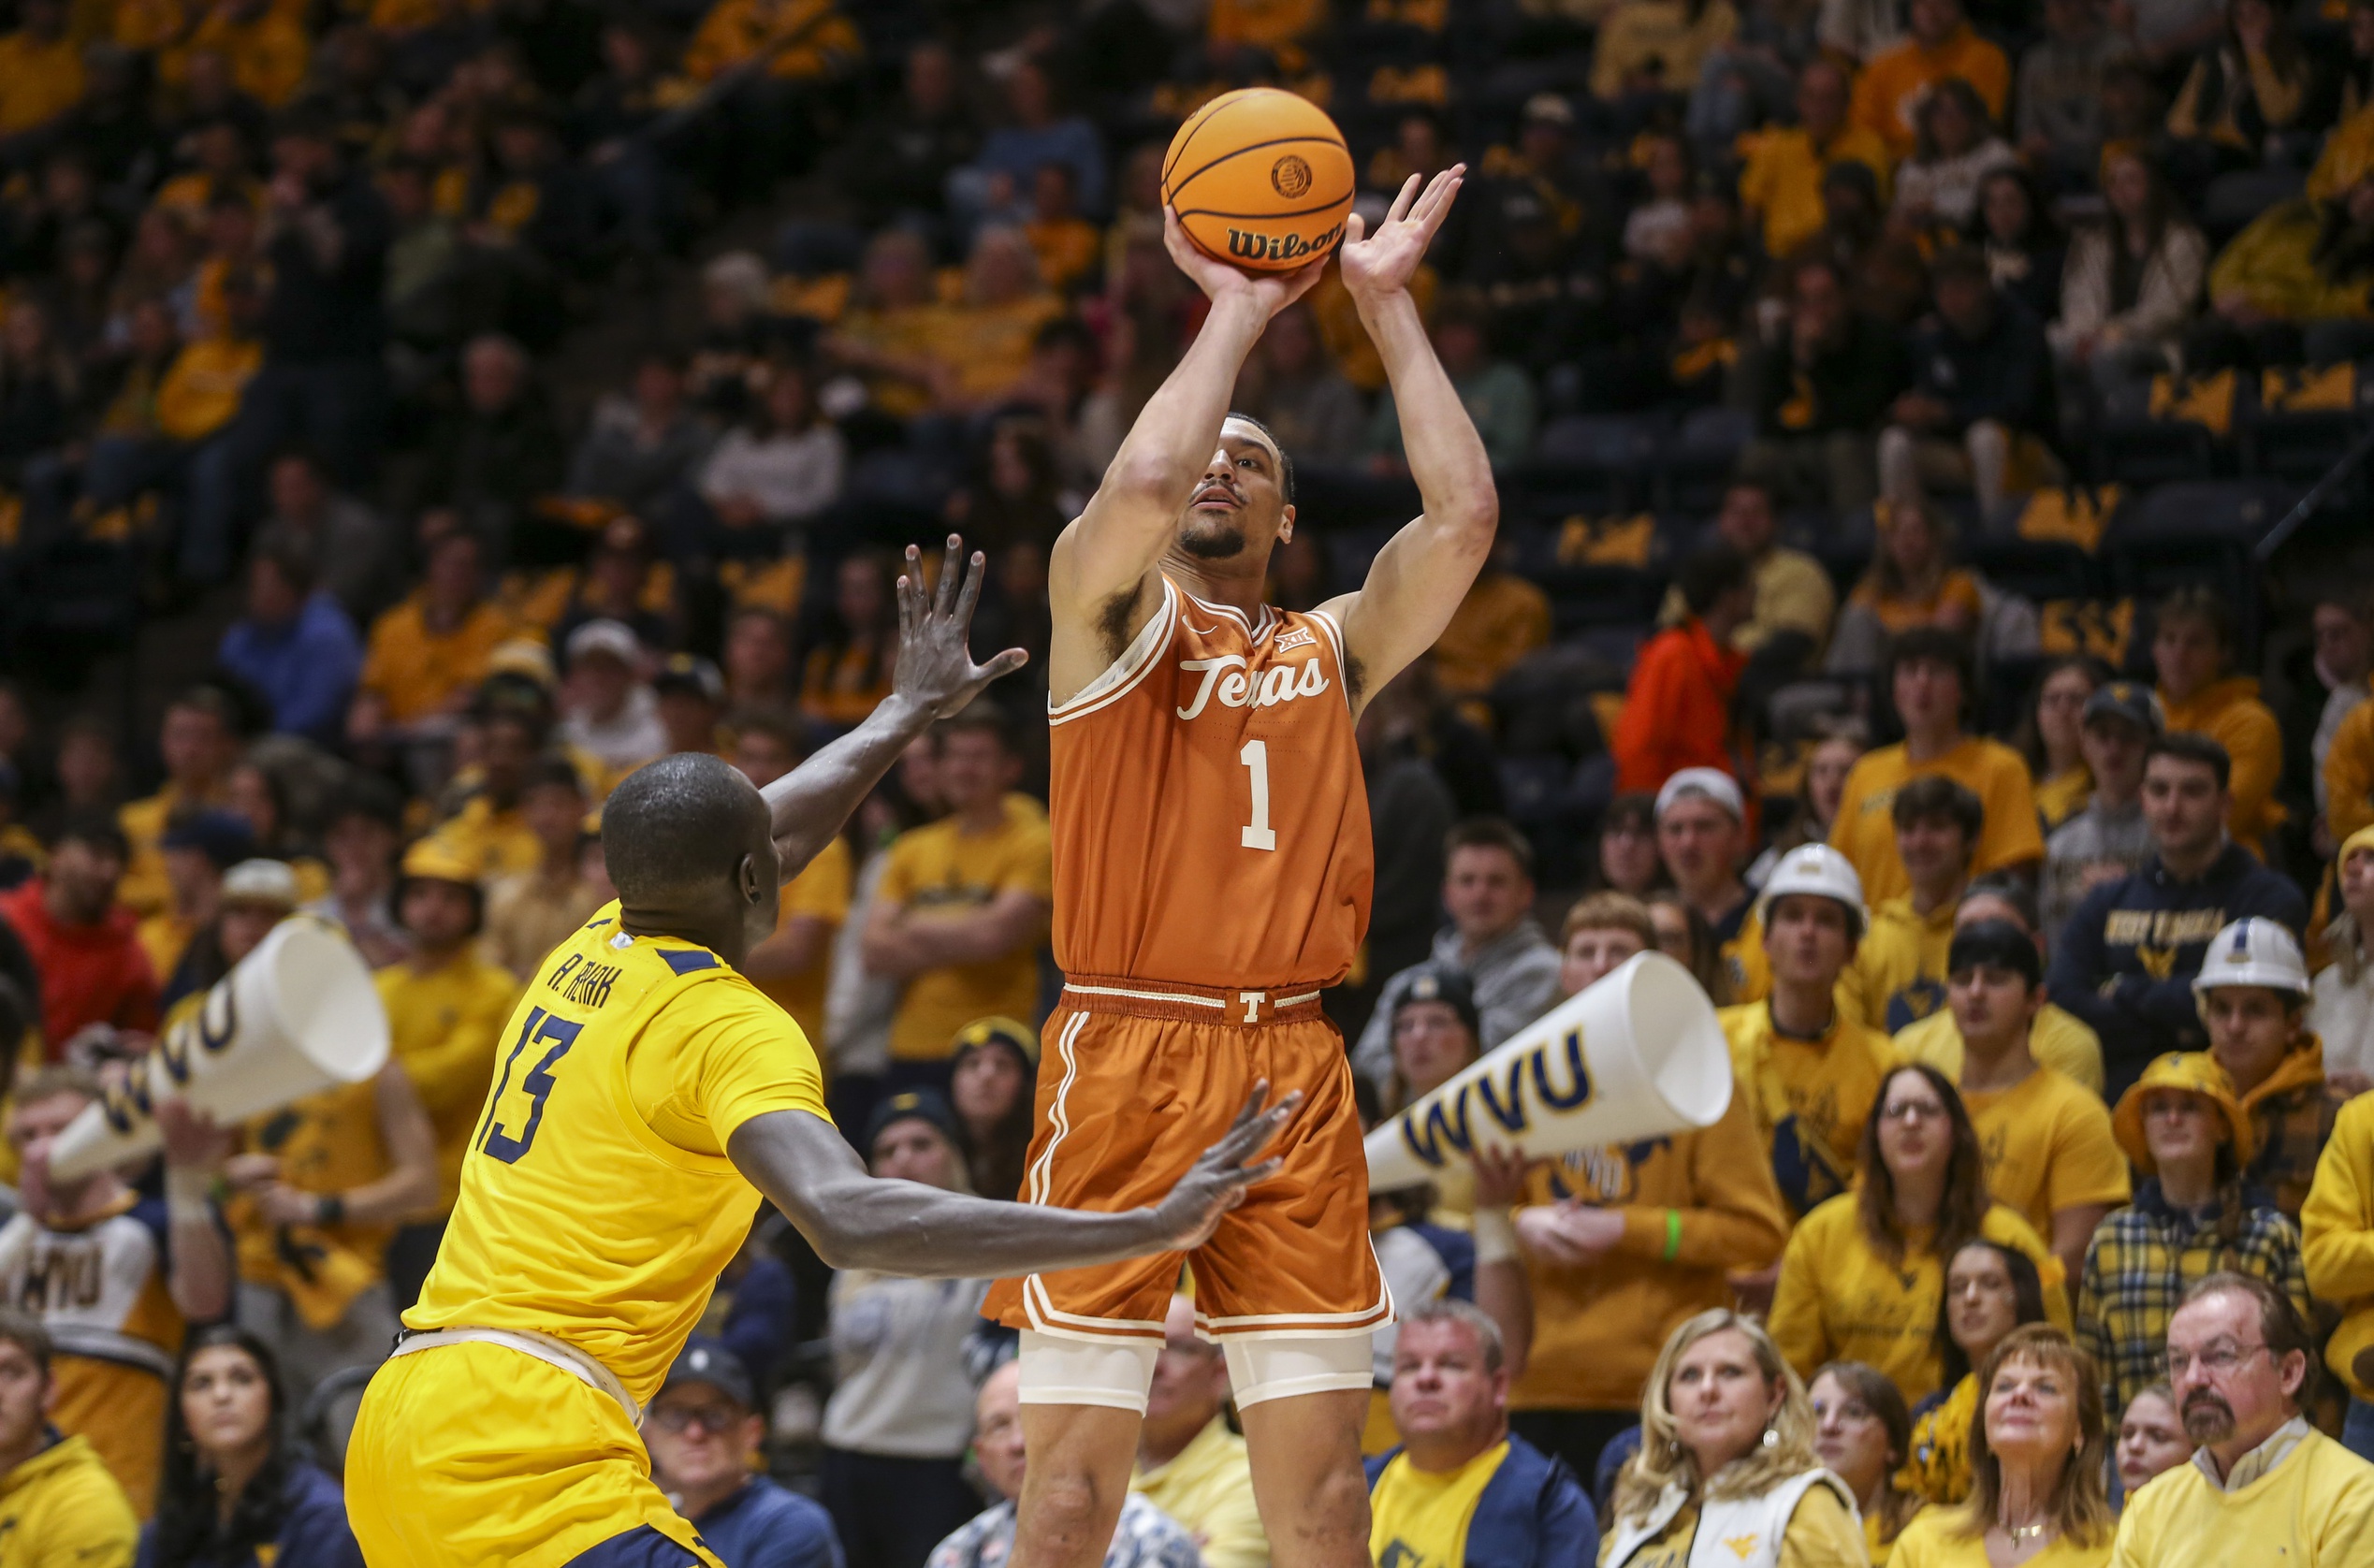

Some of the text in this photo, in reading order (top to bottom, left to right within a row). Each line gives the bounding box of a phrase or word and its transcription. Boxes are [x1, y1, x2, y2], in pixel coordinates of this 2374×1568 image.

[1227, 221, 1343, 261] Wilson
[1274, 628, 1313, 651] XII
[1176, 654, 1330, 720] Texas
[1240, 739, 1276, 851] 1
[547, 952, 584, 992] A.
[1239, 992, 1266, 1024] T
[475, 1005, 585, 1165] 13
[1402, 1024, 1593, 1166] WVU
